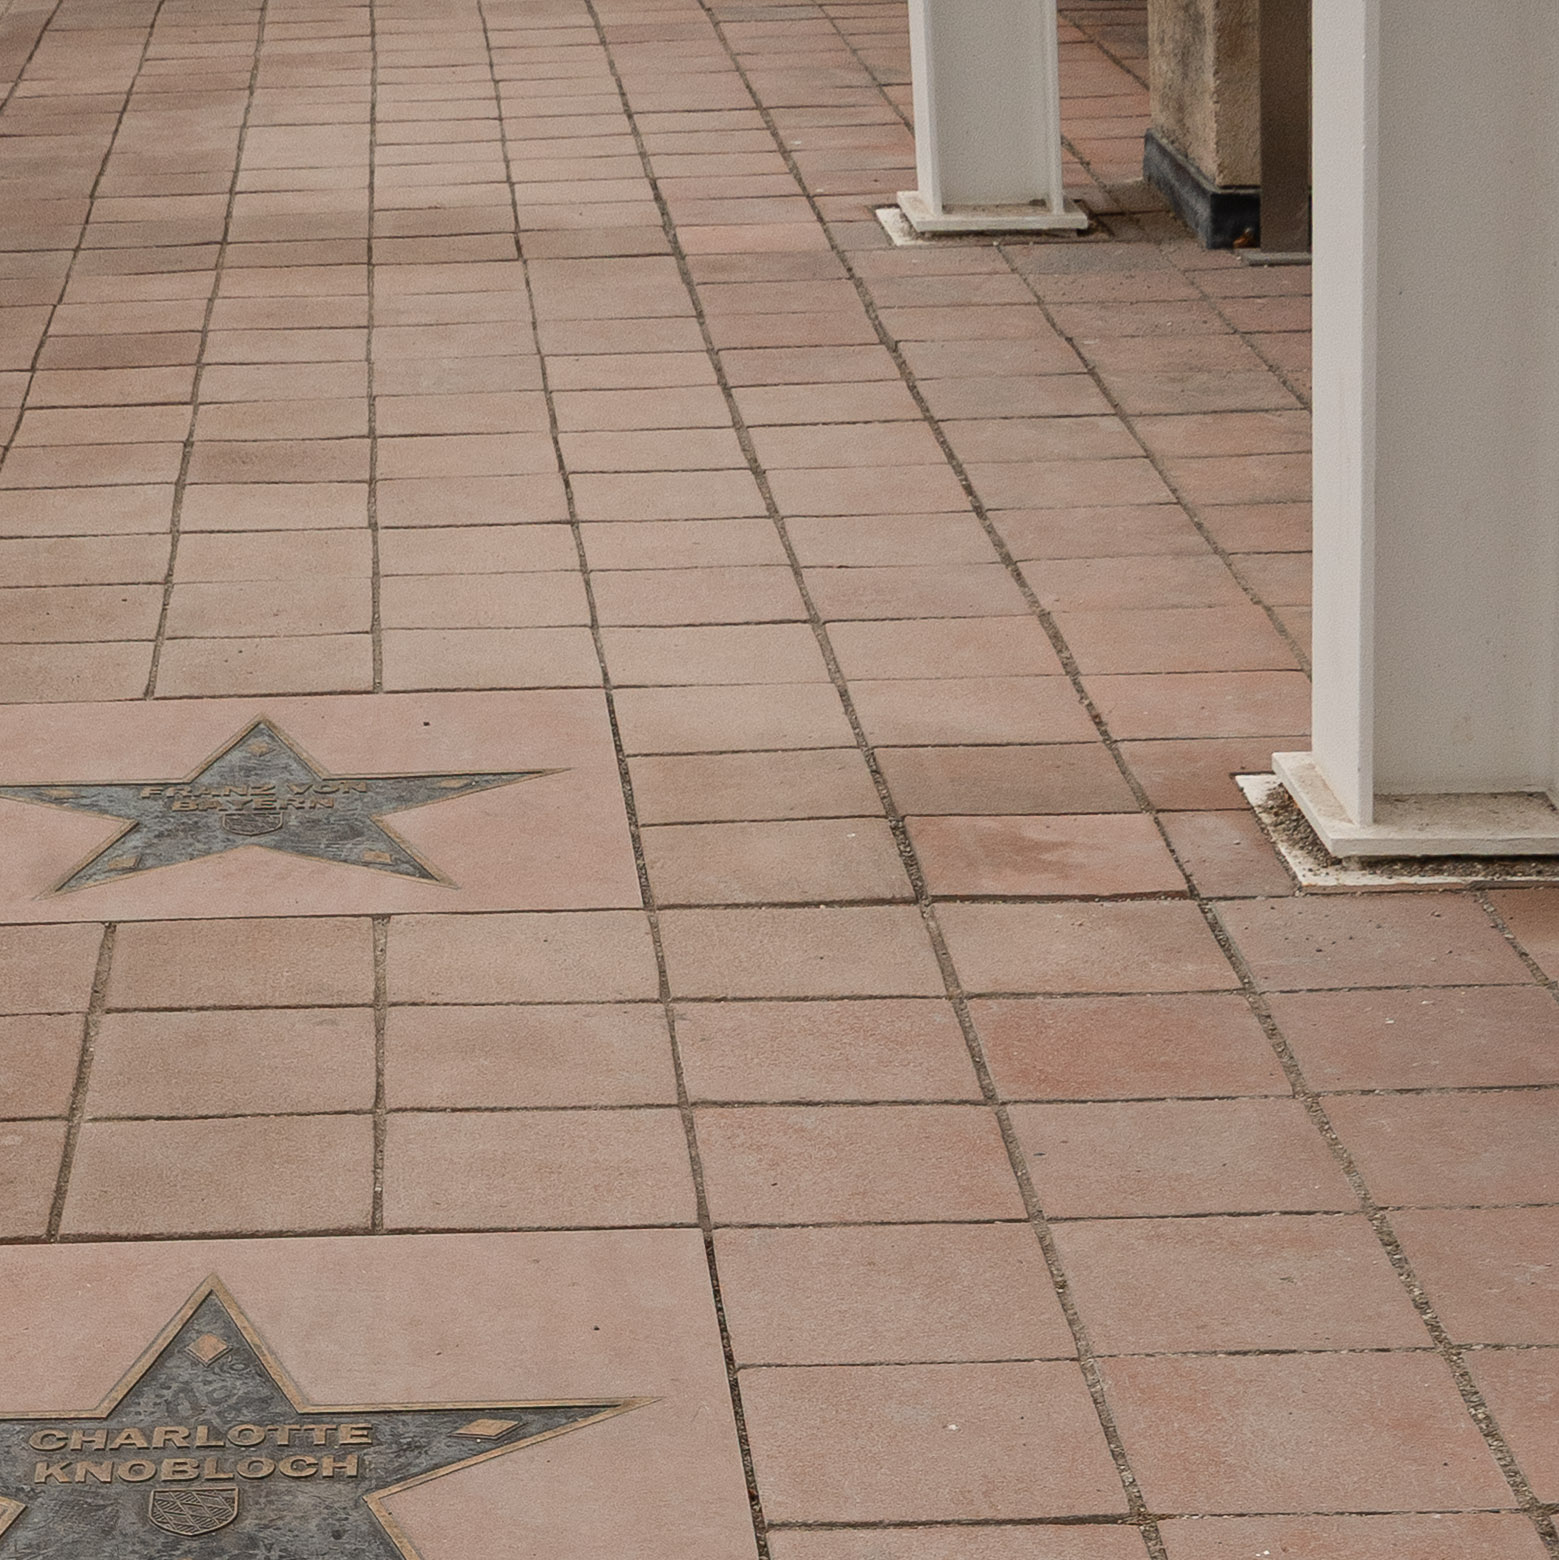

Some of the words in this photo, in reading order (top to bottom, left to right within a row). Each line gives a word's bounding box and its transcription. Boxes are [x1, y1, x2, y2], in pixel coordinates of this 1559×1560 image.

[141, 784, 277, 799] FRANZ
[287, 780, 369, 796] VON
[171, 798, 336, 813] BAYERN
[28, 1422, 374, 1452] CHARLOTTE
[33, 1453, 361, 1485] KNOBLOCH
